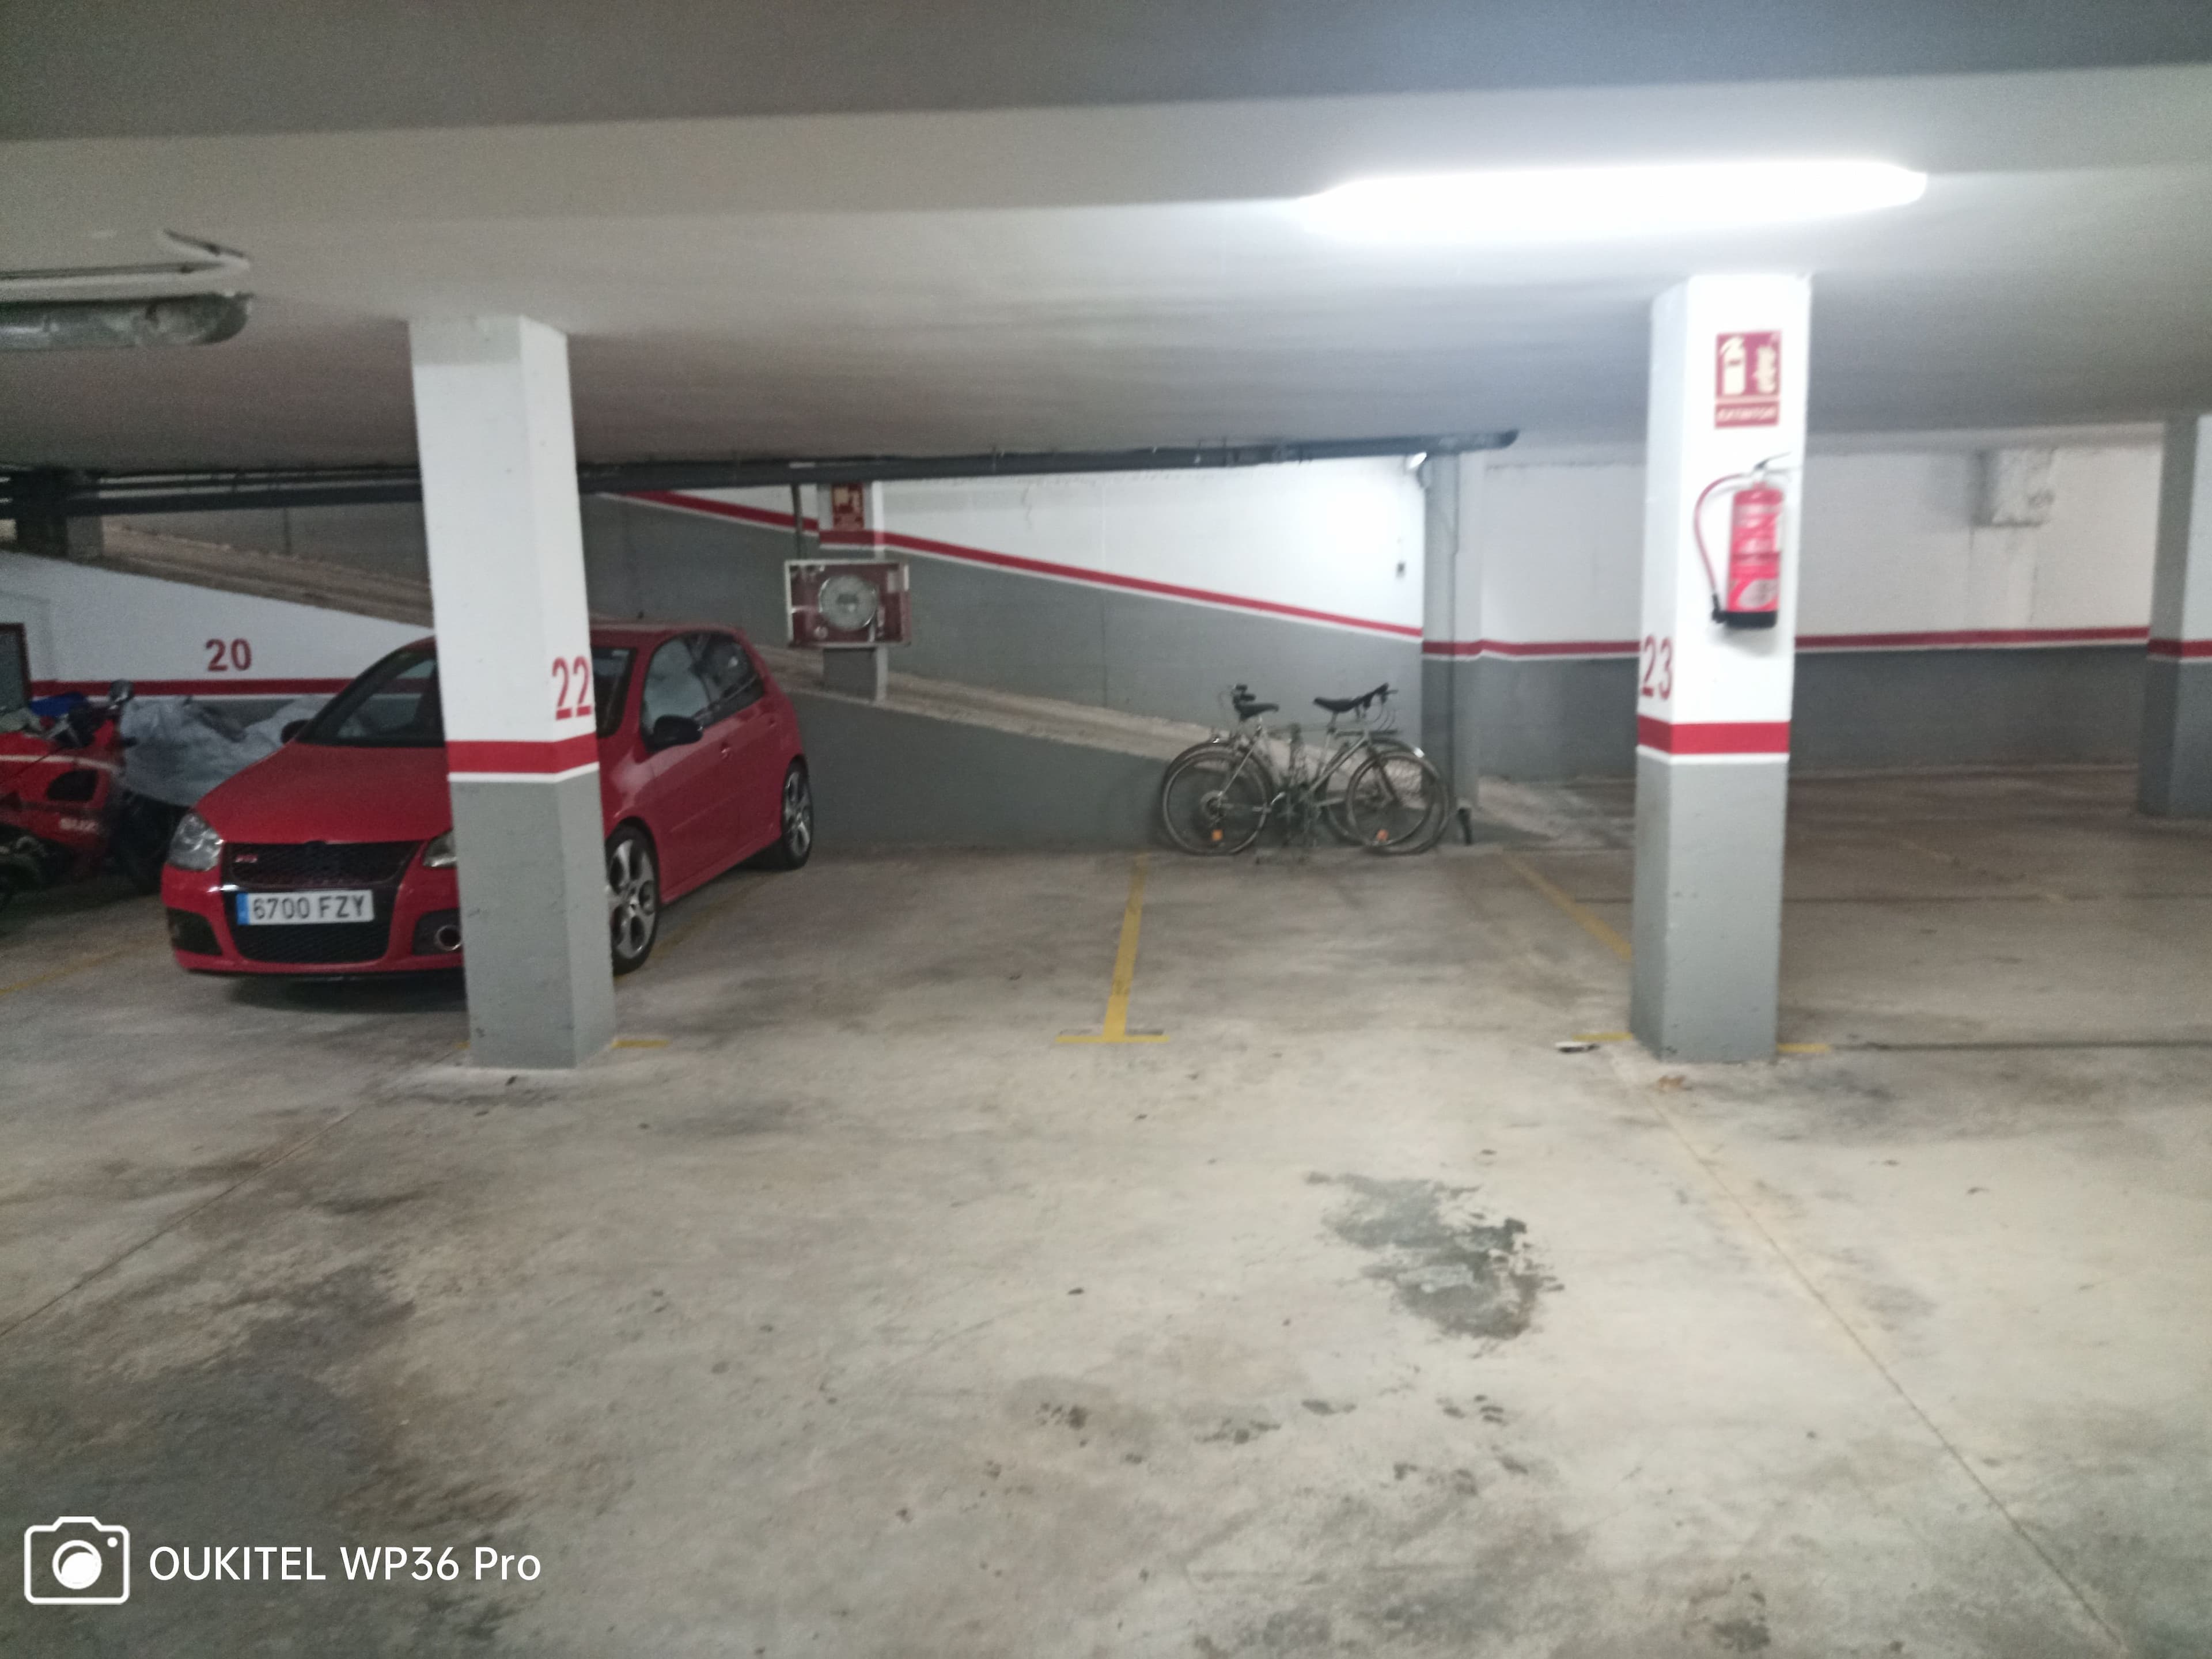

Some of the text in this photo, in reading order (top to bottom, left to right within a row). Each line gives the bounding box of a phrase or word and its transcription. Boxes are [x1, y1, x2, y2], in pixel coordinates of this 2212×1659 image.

[206, 638, 252, 672] 20
[1641, 635, 1673, 700] 23
[552, 656, 592, 721] 22
[252, 895, 365, 920] 6700 FZY
